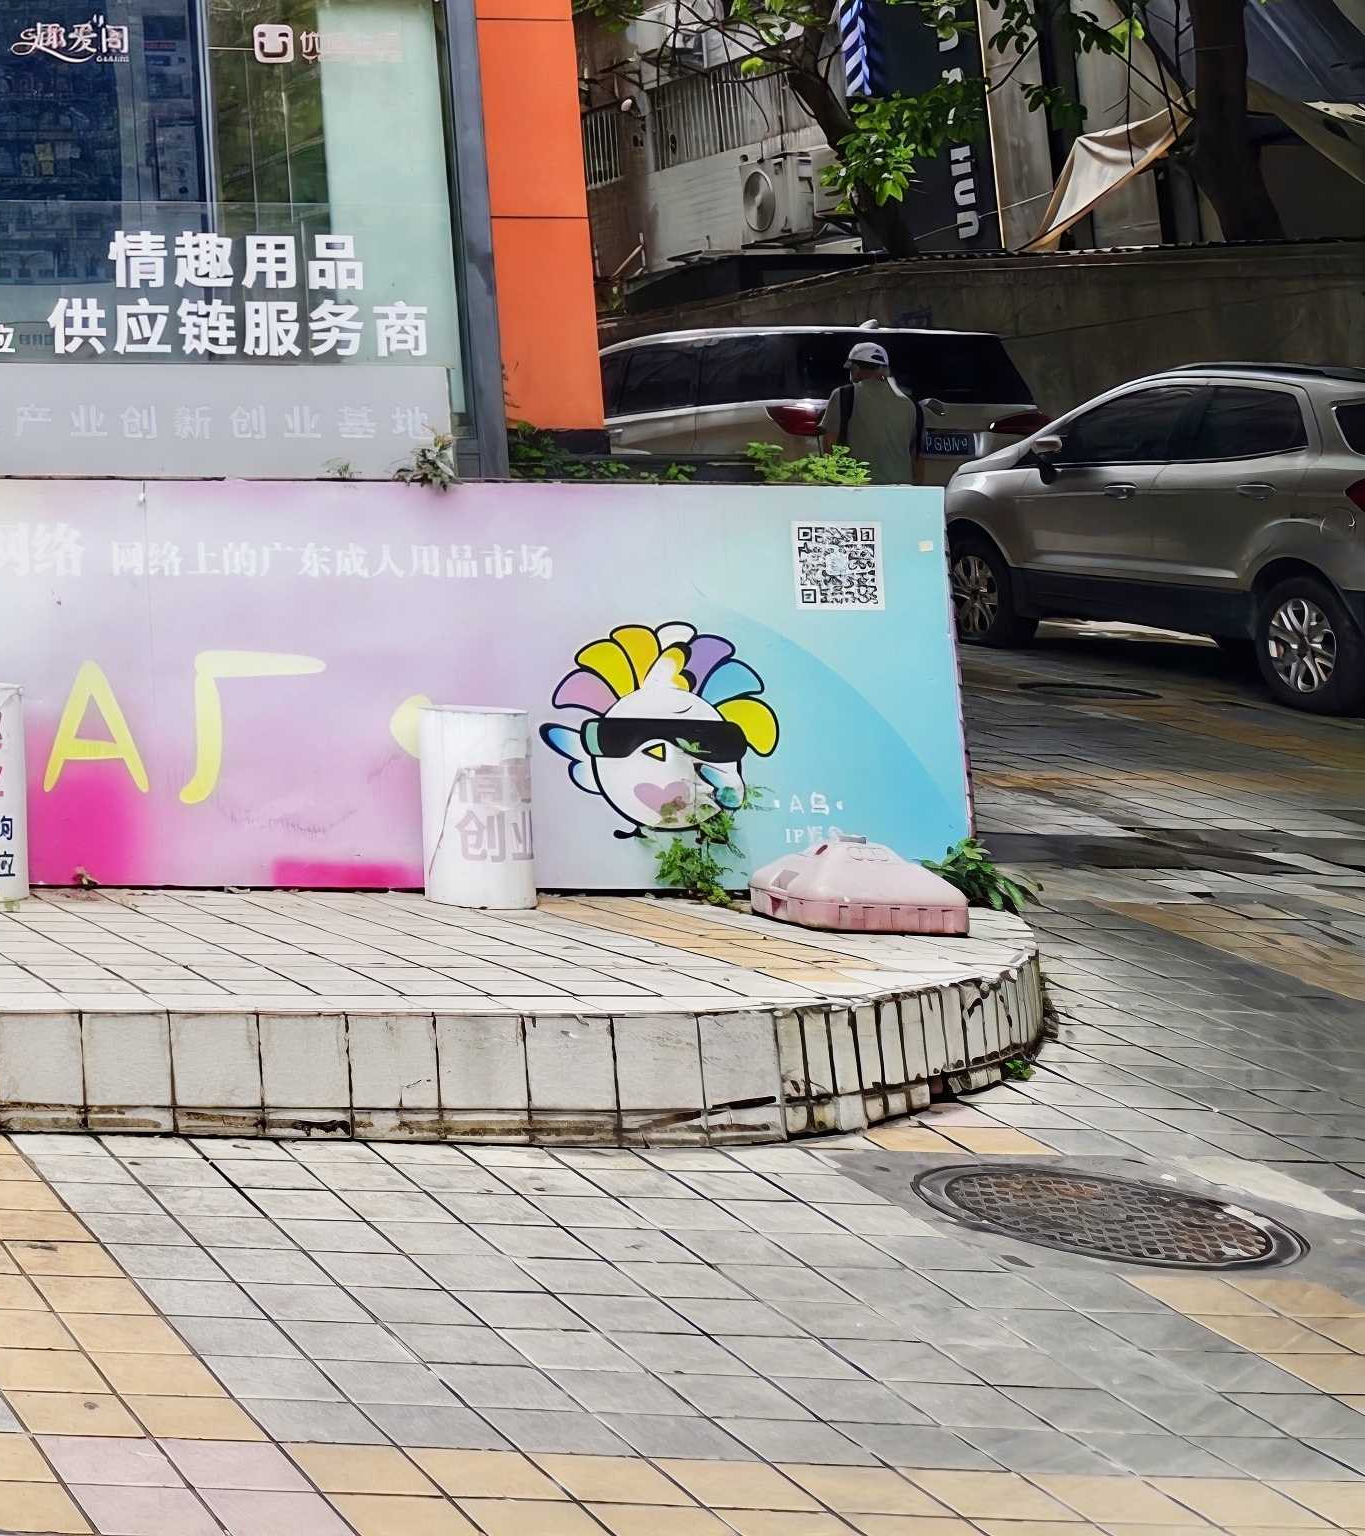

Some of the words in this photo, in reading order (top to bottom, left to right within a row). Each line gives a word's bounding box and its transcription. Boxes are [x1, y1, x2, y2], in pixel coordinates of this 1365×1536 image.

[108, 230, 364, 290] 情趣用品
[47, 297, 428, 357] 供应链服务商
